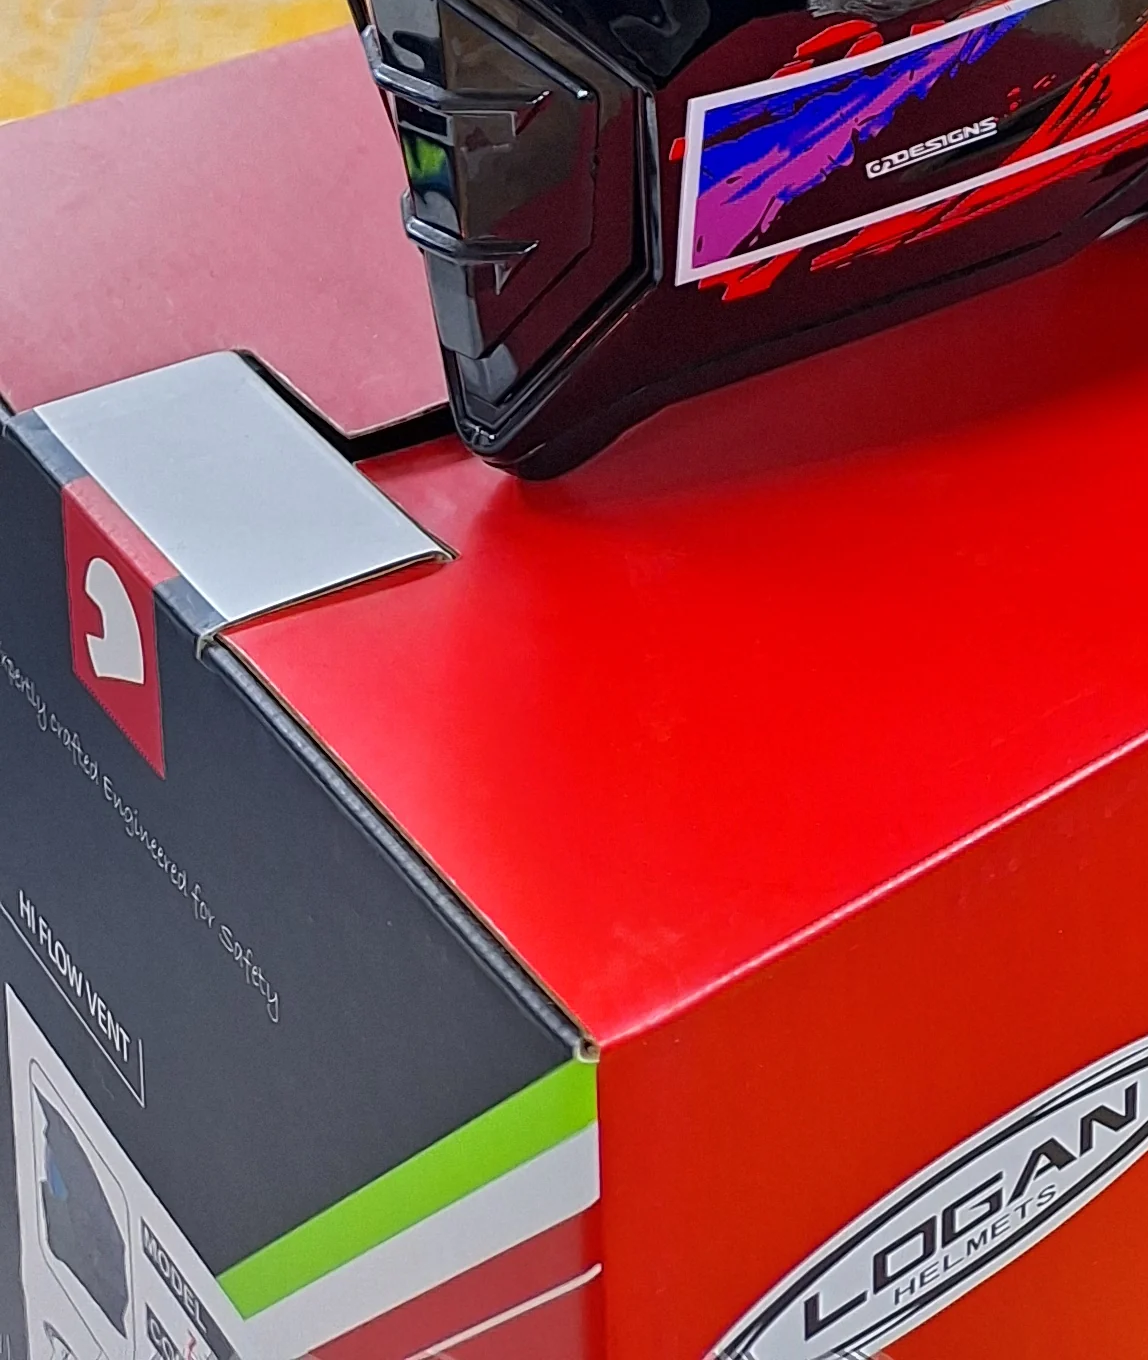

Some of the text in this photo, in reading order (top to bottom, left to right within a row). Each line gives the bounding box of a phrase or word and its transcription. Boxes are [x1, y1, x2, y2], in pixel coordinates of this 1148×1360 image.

[18, 889, 132, 1063] HI FLOW VENT
[103, 774, 188, 898] Engineered
[190, 882, 216, 930] for
[218, 924, 281, 1024] Safety
[141, 1223, 208, 1336] MODEL
[803, 1080, 1140, 1343] LOGAN
[893, 1183, 1057, 1308] HELMETS
